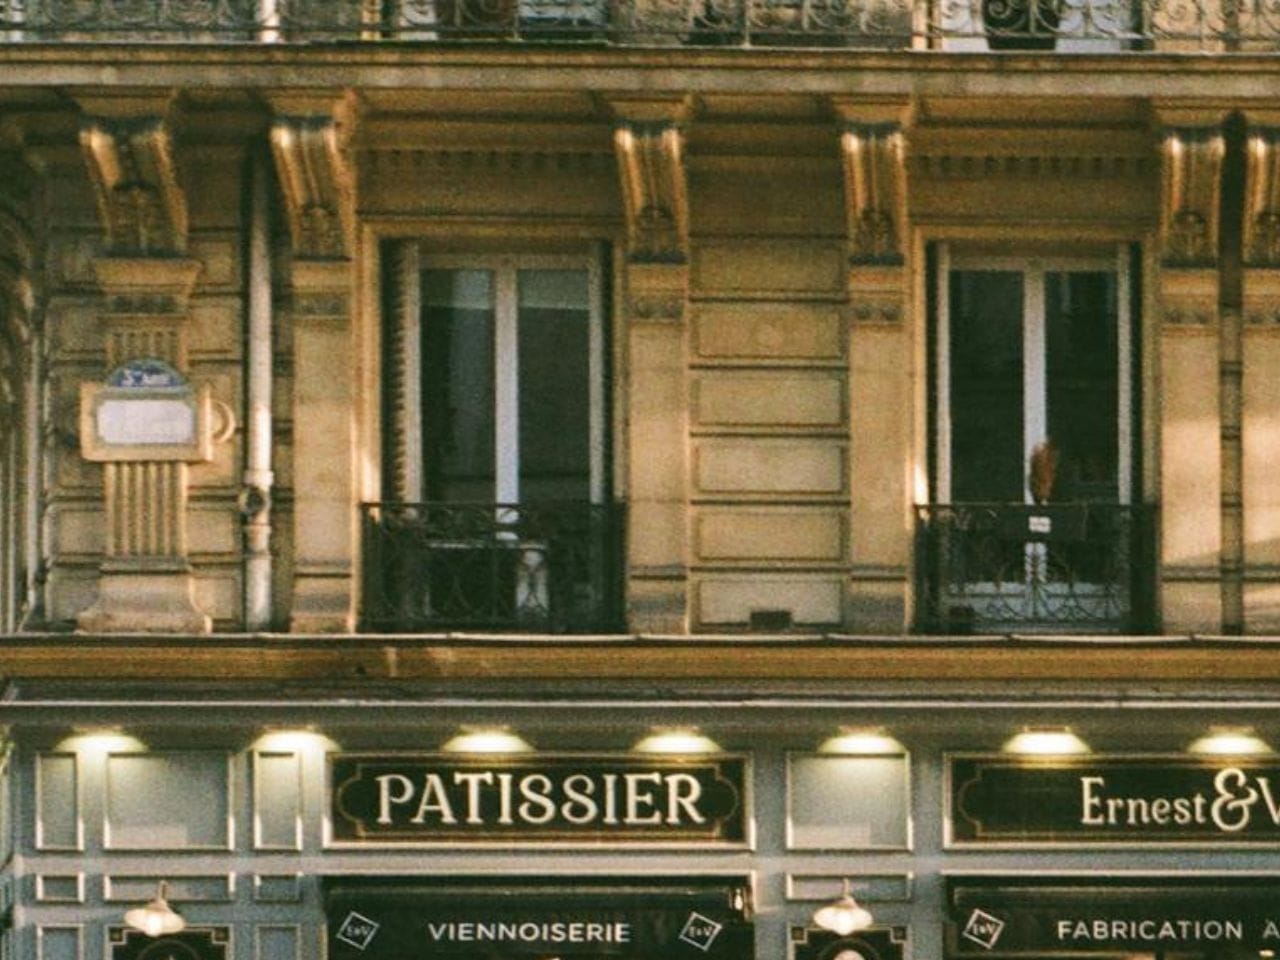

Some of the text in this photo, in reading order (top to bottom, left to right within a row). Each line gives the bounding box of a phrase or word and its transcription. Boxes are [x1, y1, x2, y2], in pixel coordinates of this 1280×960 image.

[375, 771, 706, 825] PATISSIER
[1080, 776, 1205, 825] Ernest
[1211, 768, 1258, 832] &
[428, 921, 631, 943] VIENNOISERIE
[1057, 919, 1244, 941] FABRICATION
